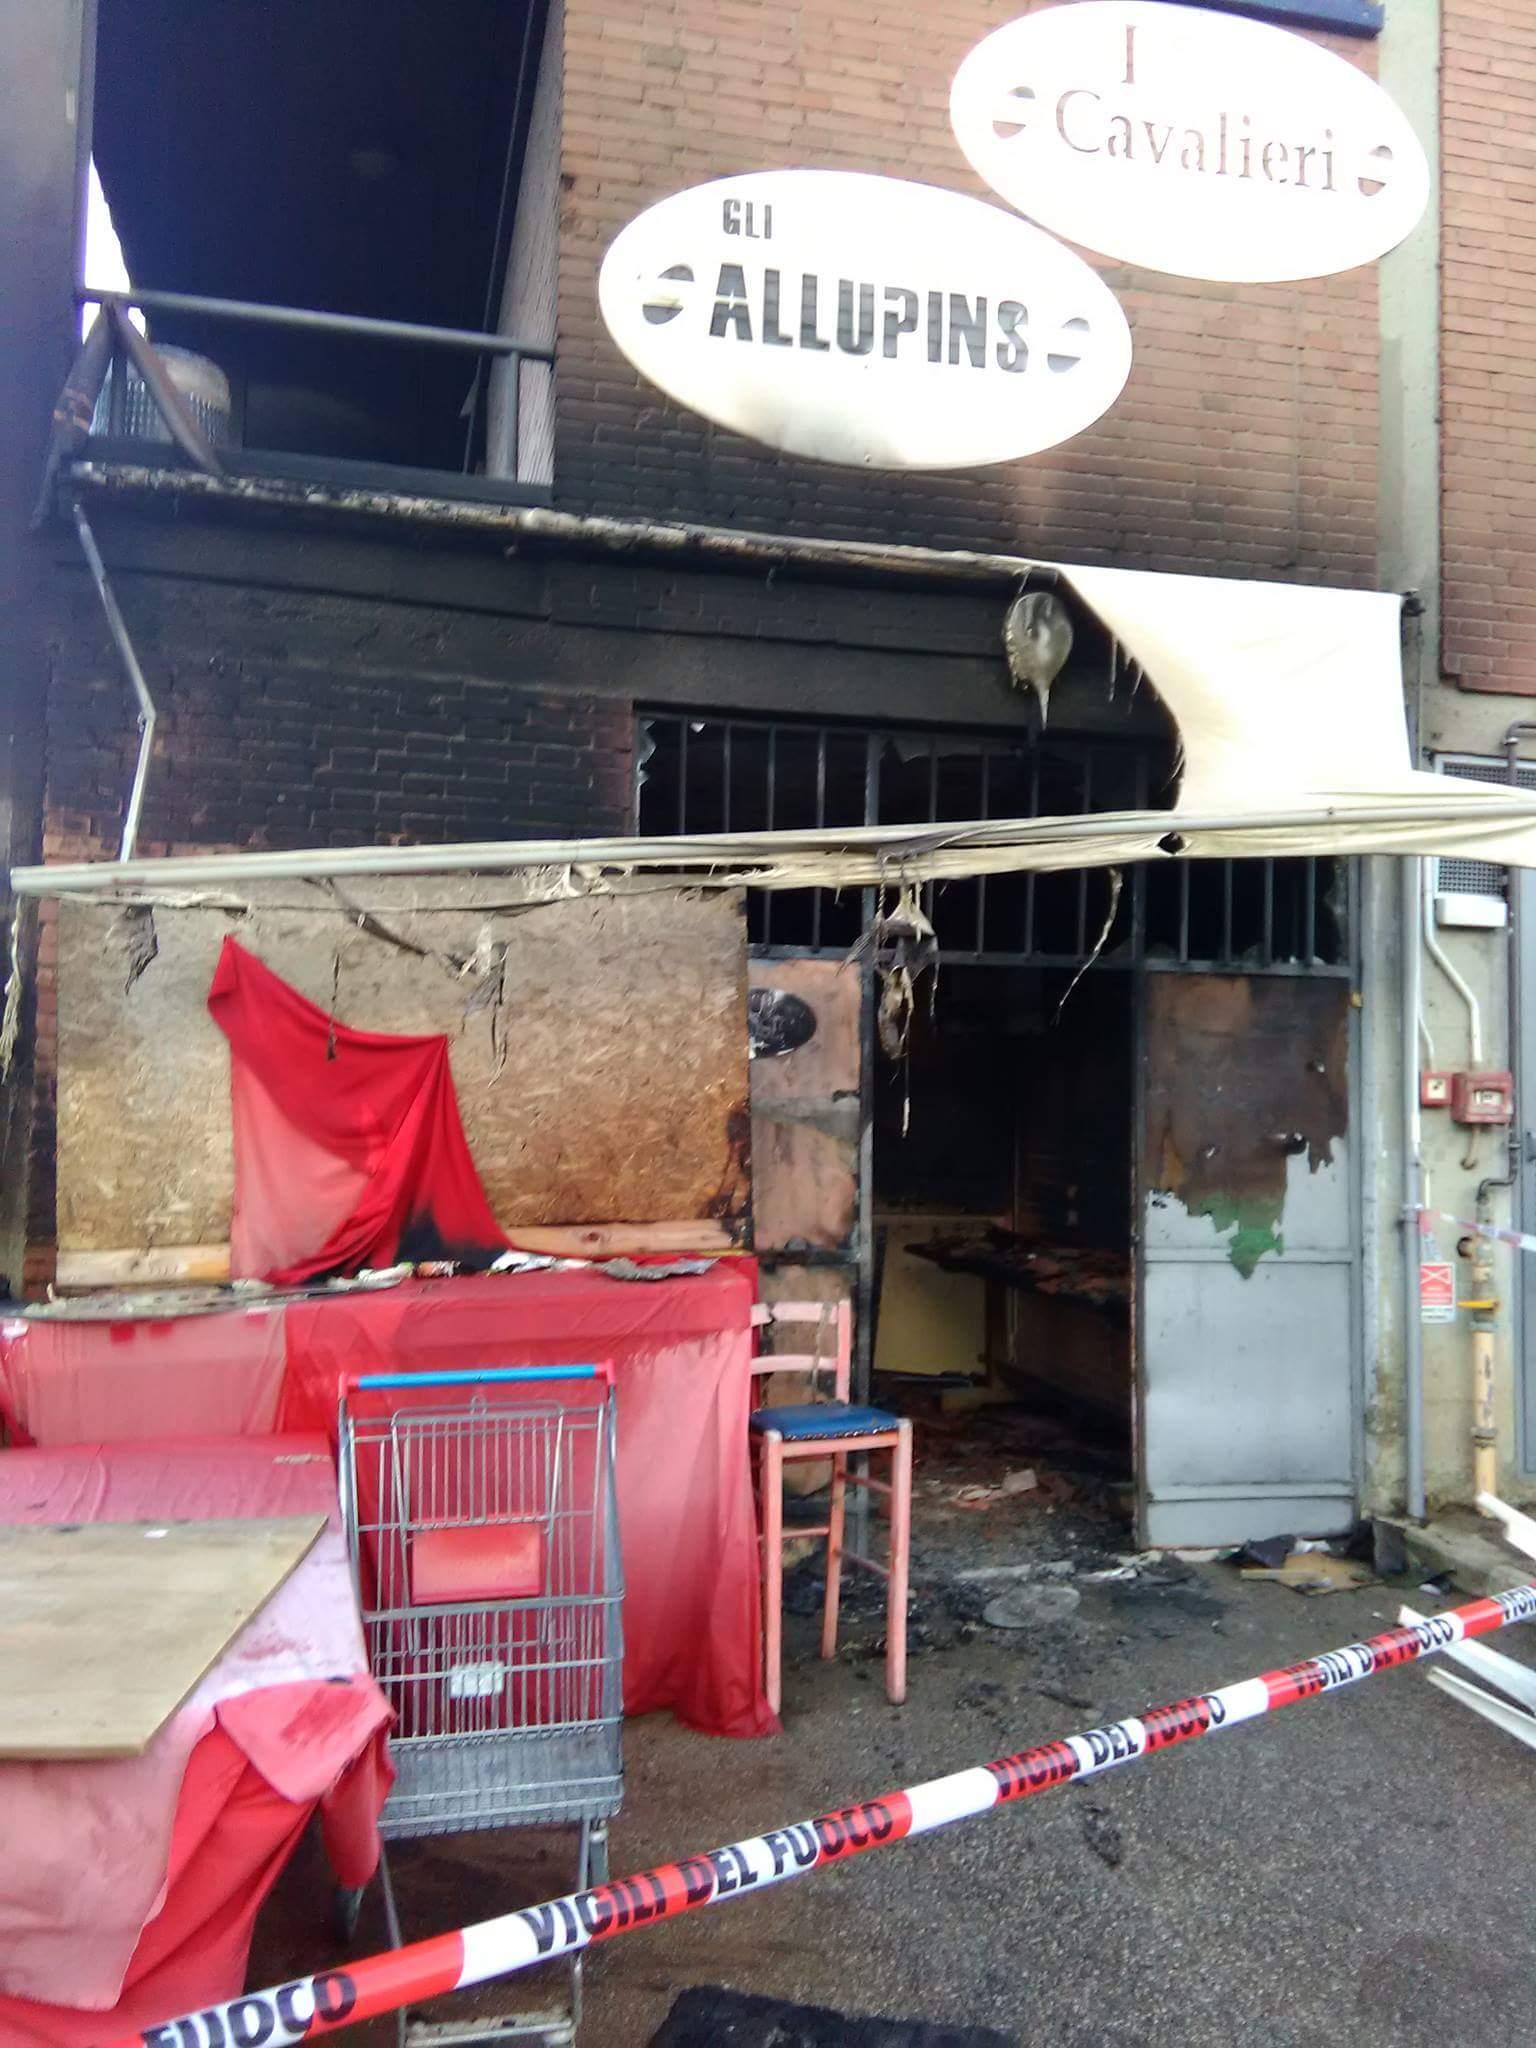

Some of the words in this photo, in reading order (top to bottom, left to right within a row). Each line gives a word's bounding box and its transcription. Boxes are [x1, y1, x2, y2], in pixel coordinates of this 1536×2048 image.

[1121, 24, 1137, 84] I
[1056, 89, 1337, 192] Cavalieri
[722, 198, 772, 239] GLI
[709, 262, 1029, 373] ALLUPINS
[1352, 1639, 1393, 1673] DEL
[983, 1742, 1081, 1797] VIGILI
[1080, 1724, 1139, 1767] DEL
[1137, 1695, 1226, 1746] FUOCO
[517, 1872, 667, 1954] VIGILI
[675, 1845, 758, 1903] DEL
[762, 1802, 894, 1877] FUOCO
